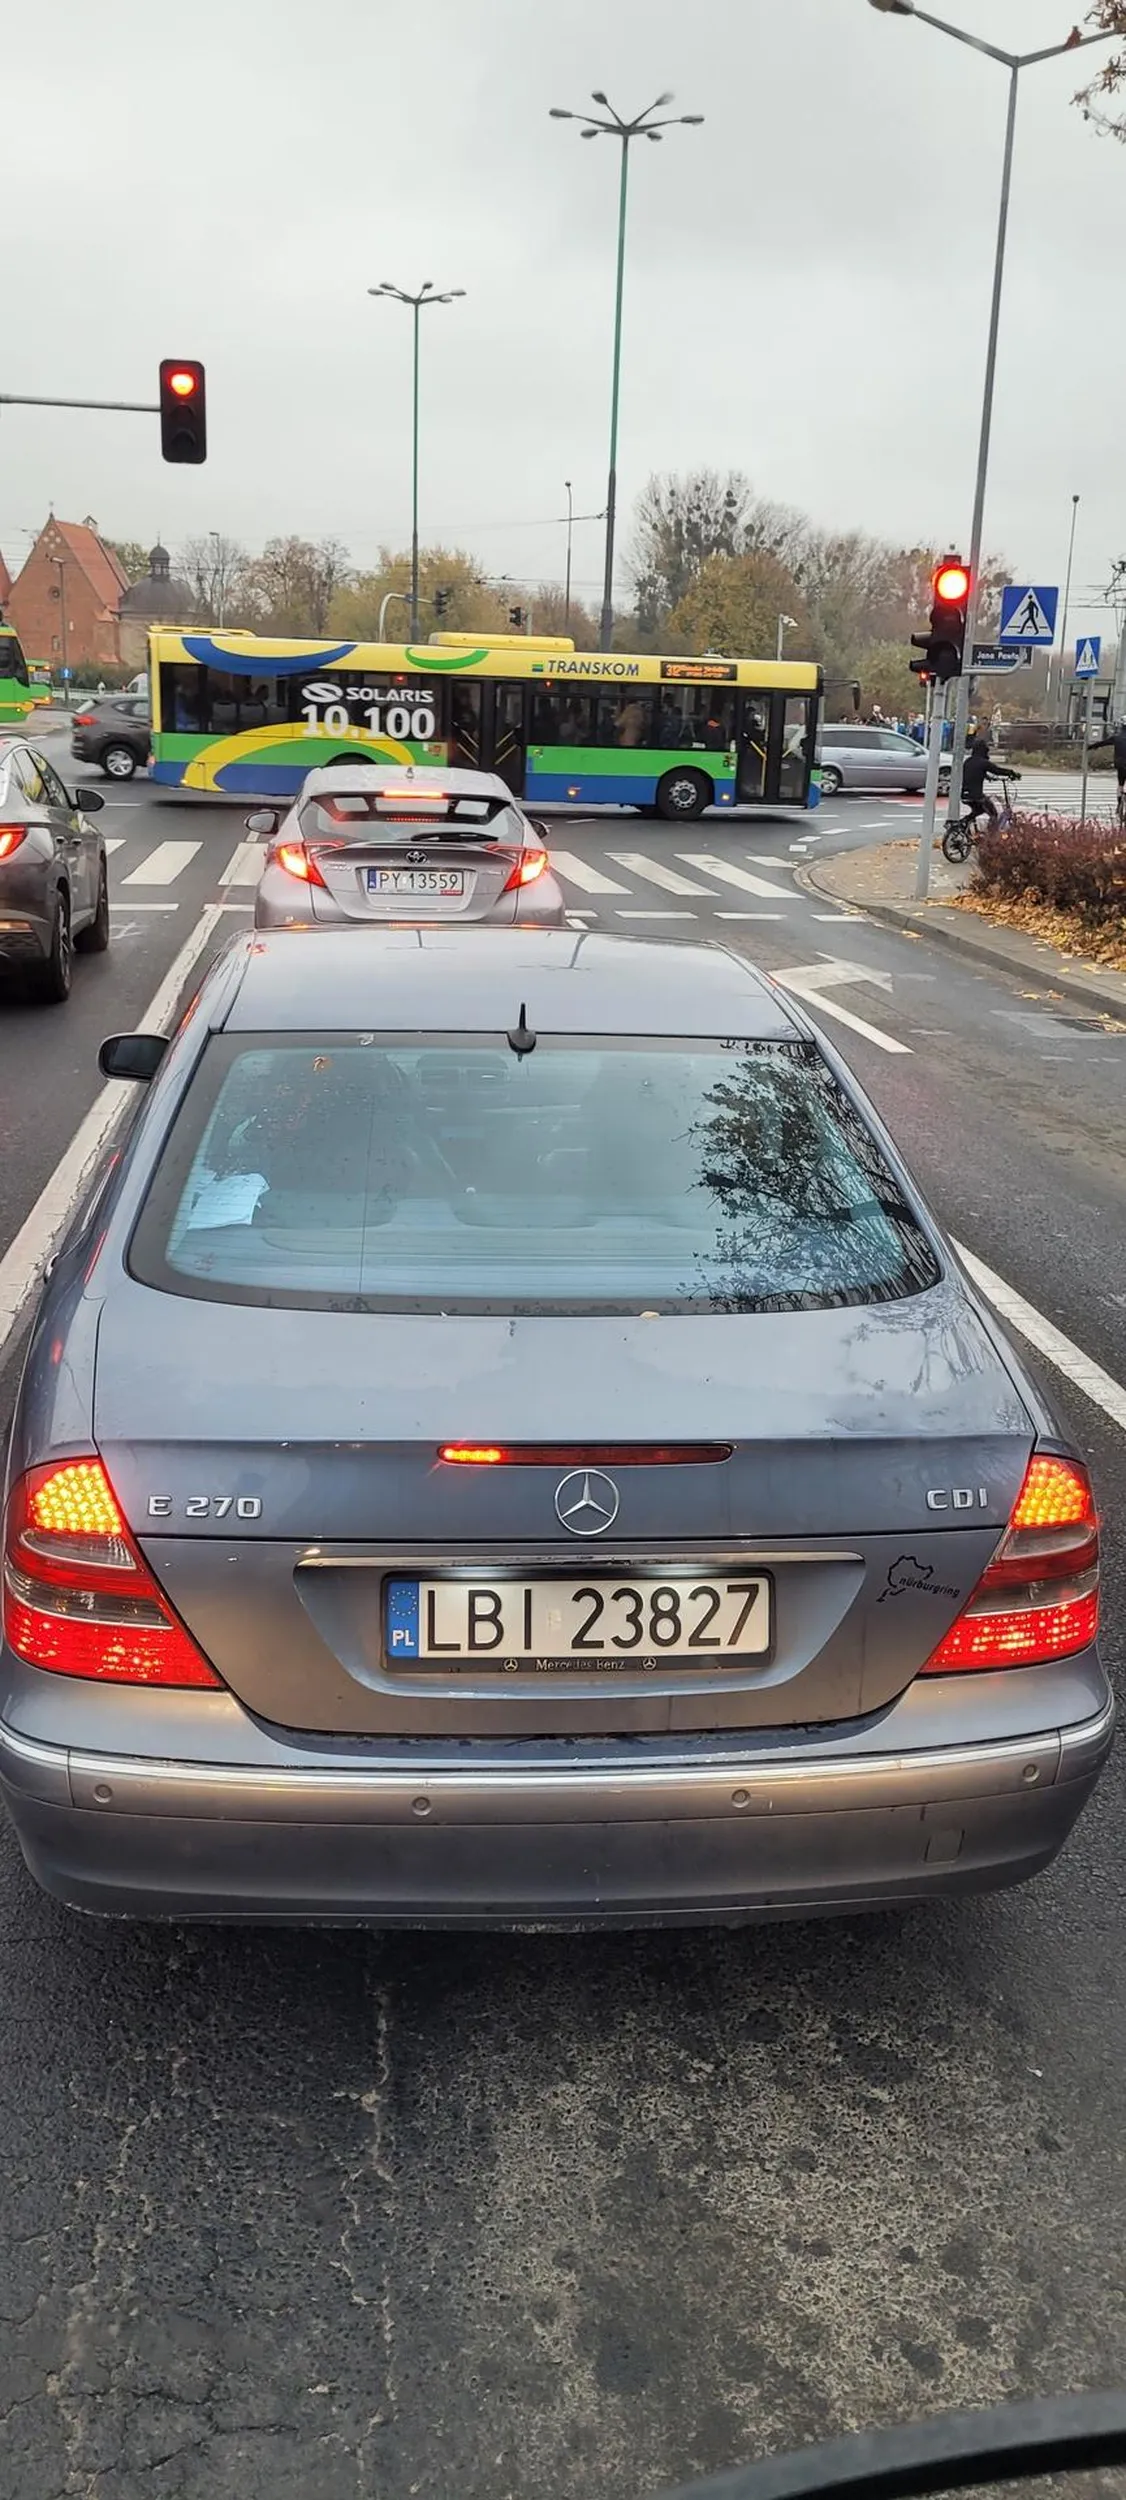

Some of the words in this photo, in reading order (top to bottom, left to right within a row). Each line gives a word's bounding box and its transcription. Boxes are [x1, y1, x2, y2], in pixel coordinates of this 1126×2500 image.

[548, 660, 639, 676] TRANSKOM
[345, 687, 434, 703] SOLARIS
[301, 704, 435, 739] 10.100
[379, 872, 401, 889] PY
[408, 873, 458, 889] 13559
[148, 1495, 172, 1516] E
[186, 1496, 262, 1518] 270
[926, 1487, 988, 1510] CDI
[427, 1588, 532, 1652] LBI
[570, 1583, 760, 1650] 23827
[391, 1629, 415, 1647] PL
